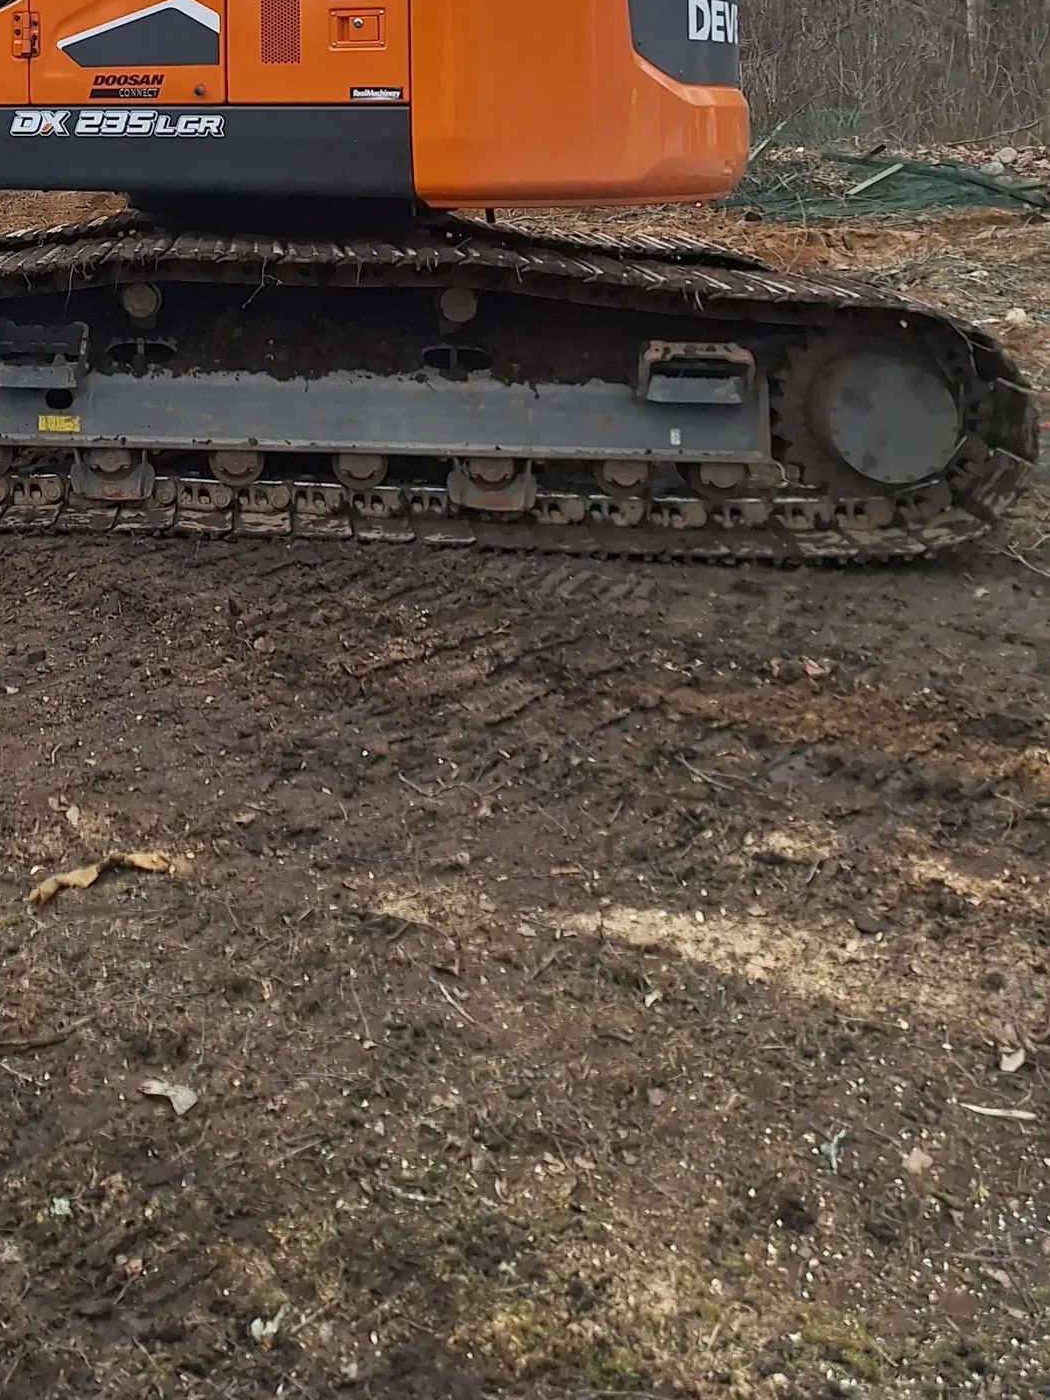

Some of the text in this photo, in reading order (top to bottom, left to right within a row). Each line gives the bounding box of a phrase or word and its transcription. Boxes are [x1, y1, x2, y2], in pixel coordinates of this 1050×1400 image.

[93, 74, 165, 86] DOOSAN
[119, 88, 158, 98] CONNECT
[352, 89, 401, 99] RealMachinery
[10, 110, 225, 138] DX 235LCR
